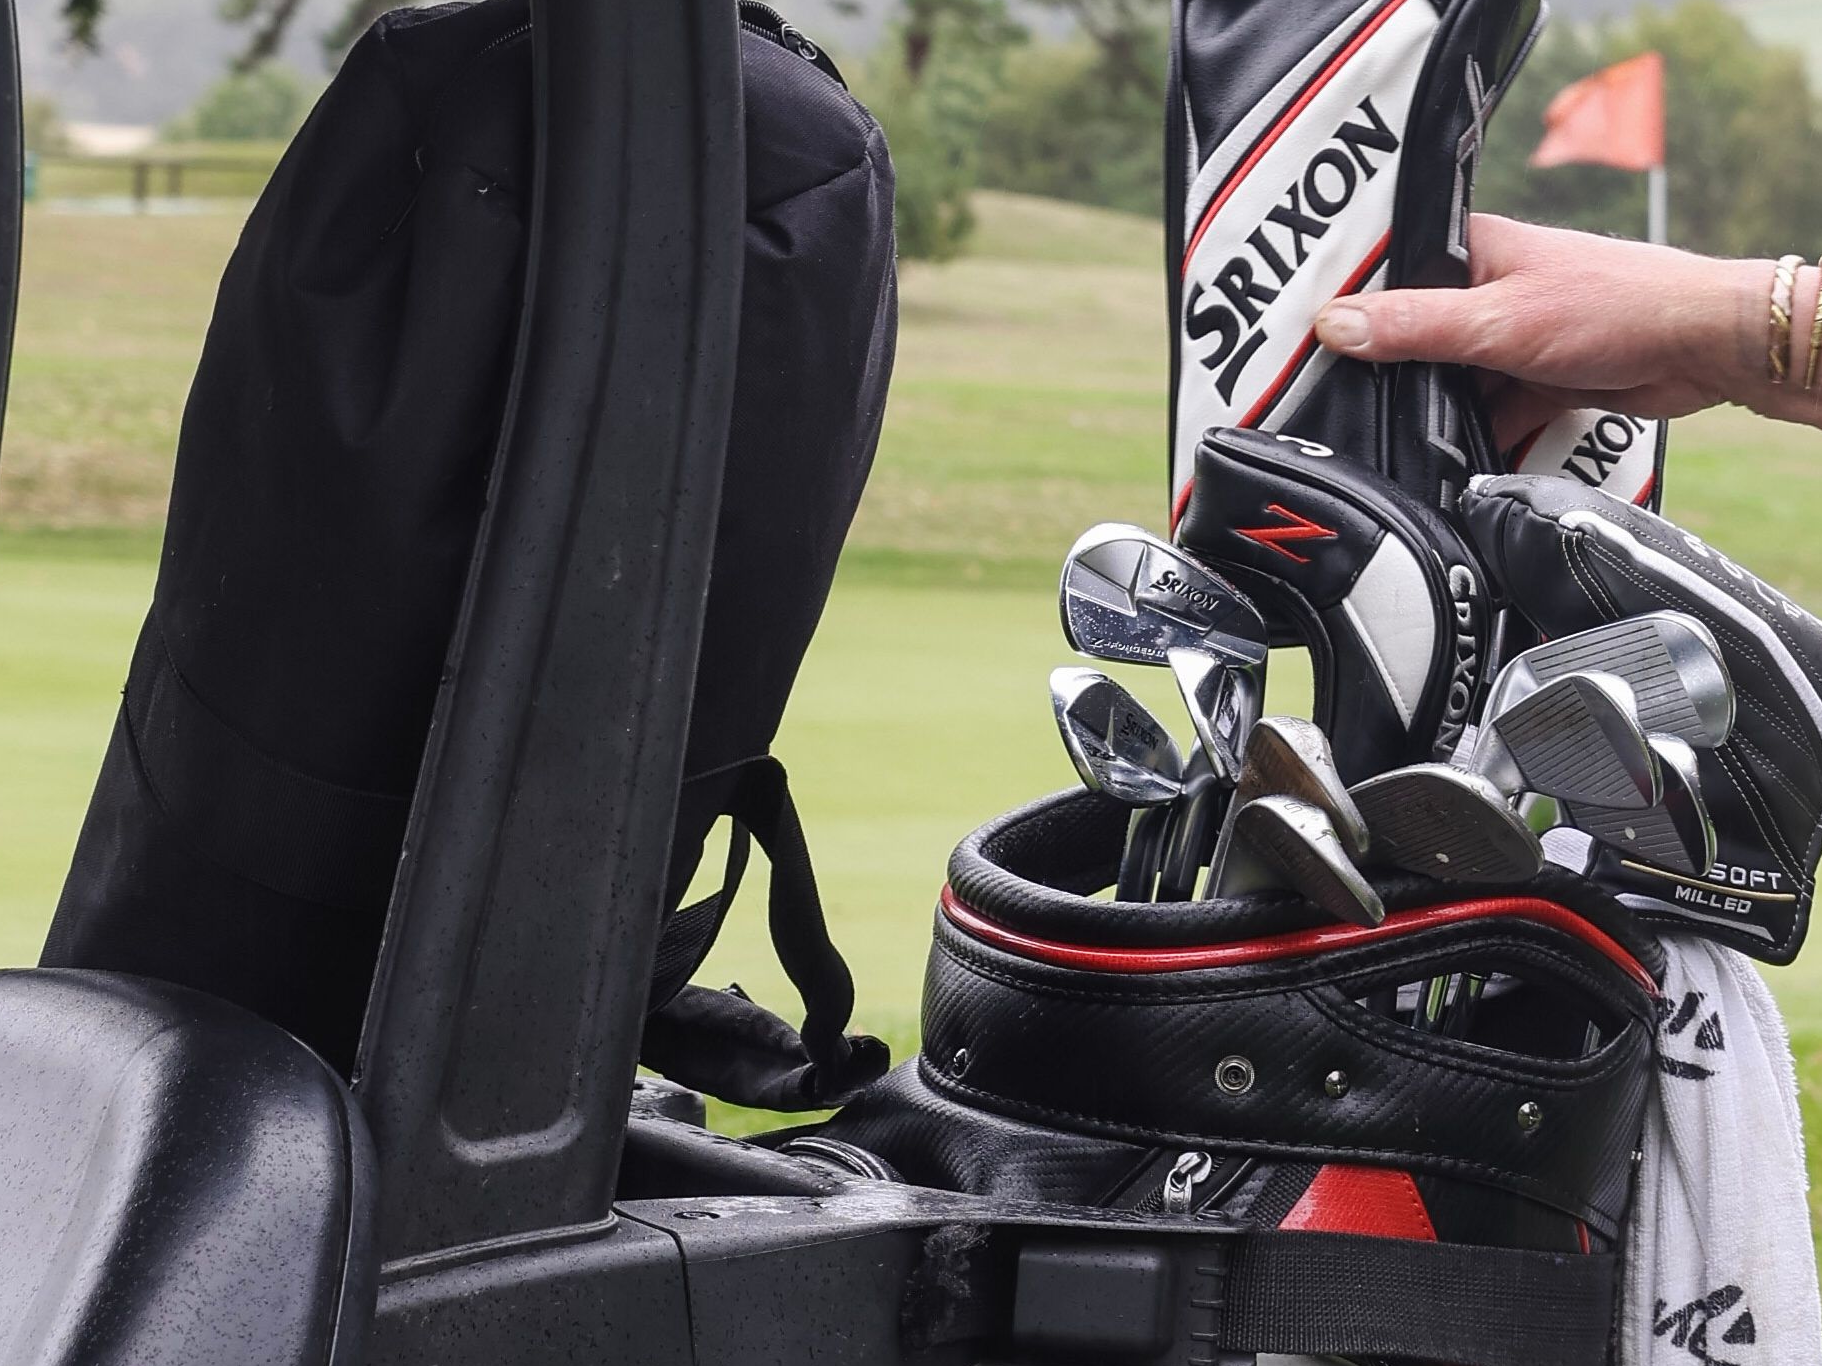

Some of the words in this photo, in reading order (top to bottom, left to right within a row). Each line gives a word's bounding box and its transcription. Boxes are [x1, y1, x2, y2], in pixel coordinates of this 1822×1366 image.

[1185, 94, 1401, 372] SRIXON
[1561, 414, 1646, 488] IXO
[1153, 570, 1219, 611] SRIXON
[1708, 862, 1782, 890] SOFT
[1675, 884, 1752, 914] MILLED
